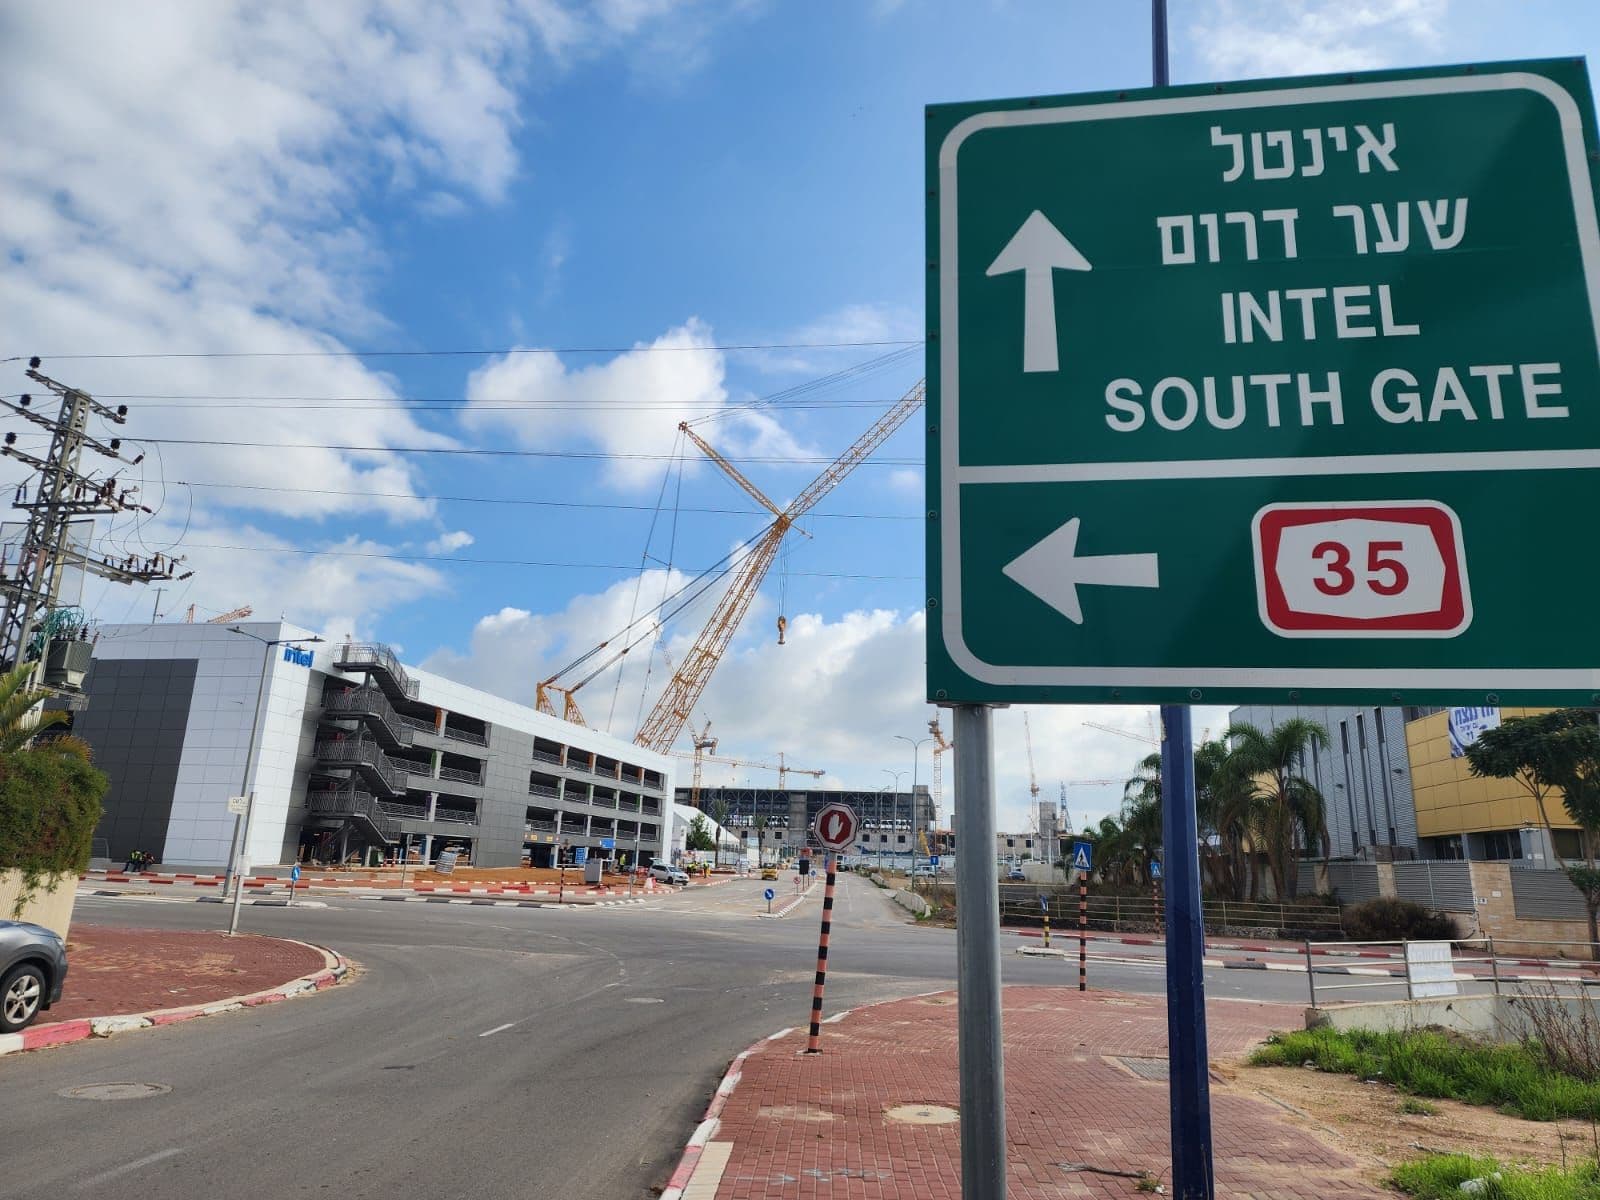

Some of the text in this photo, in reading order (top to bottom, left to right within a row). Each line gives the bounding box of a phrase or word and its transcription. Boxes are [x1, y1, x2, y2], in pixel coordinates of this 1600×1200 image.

[1211, 124, 1398, 181] אינטל
[1158, 199, 1467, 264] שער דרום
[1222, 285, 1419, 343] INTEL
[1106, 364, 1568, 431] SOUTH GATE
[1311, 541, 1409, 595] 35
[284, 643, 314, 668] intel
